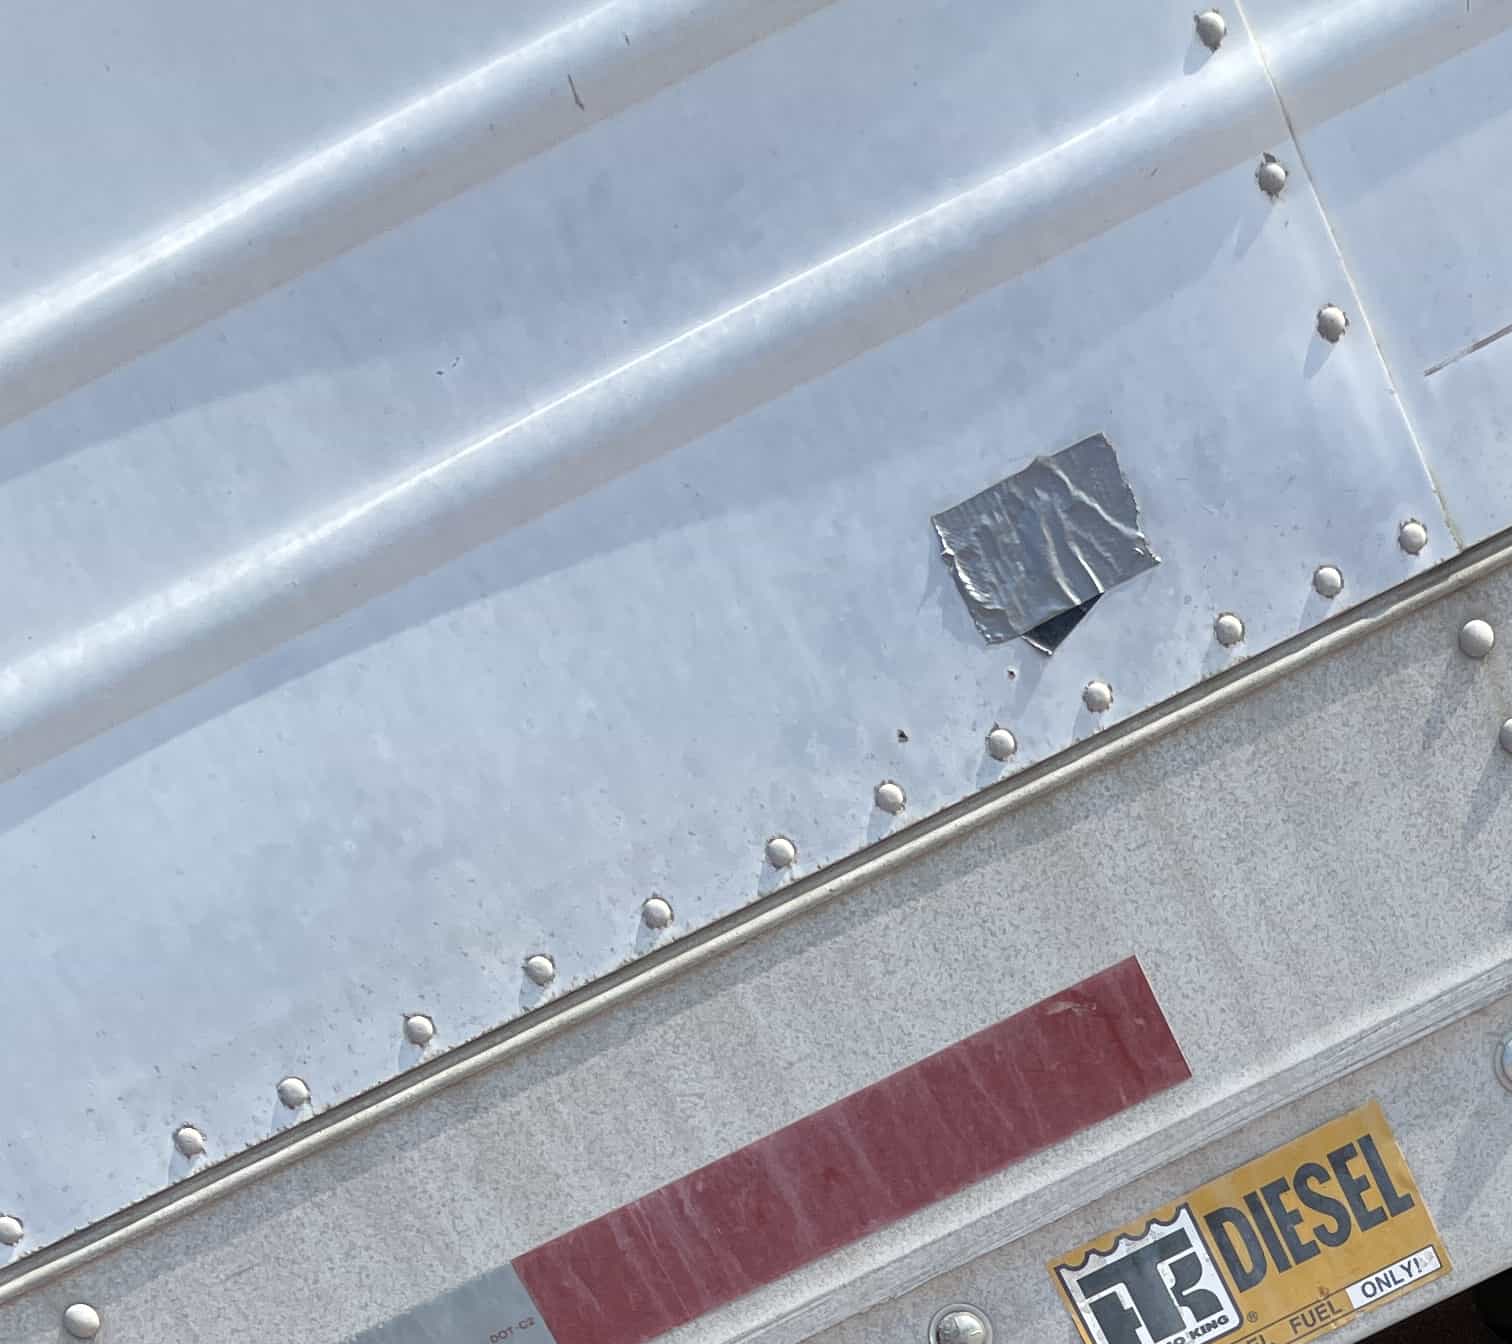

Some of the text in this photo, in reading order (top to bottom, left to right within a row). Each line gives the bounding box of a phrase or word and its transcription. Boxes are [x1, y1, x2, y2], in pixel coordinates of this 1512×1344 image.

[1203, 1134, 1415, 1293] DIESEL
[1189, 1315, 1229, 1339] KING
[1289, 1300, 1343, 1335] FUEL
[1361, 1258, 1422, 1298] ONLY!
